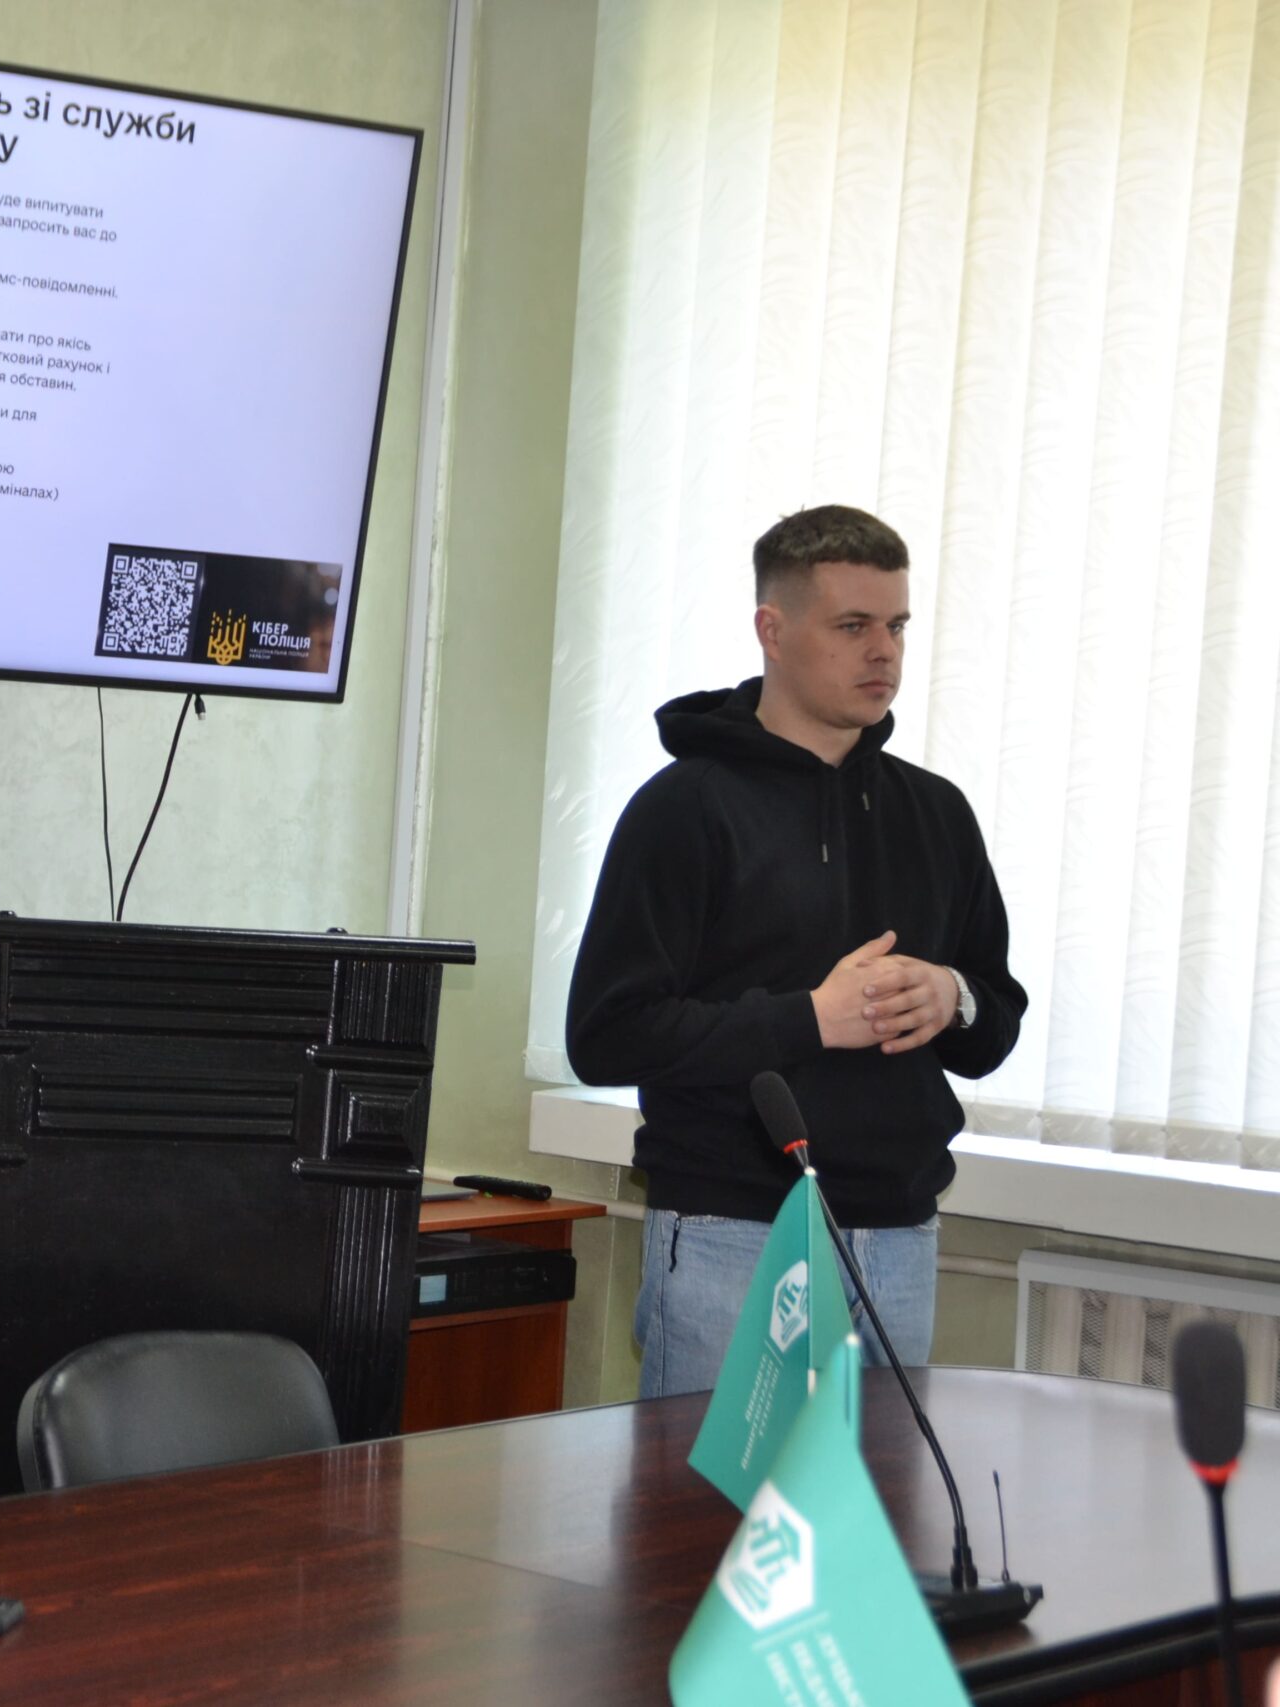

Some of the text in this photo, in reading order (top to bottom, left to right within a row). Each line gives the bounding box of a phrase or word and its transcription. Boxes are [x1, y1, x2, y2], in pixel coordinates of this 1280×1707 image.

[22, 91, 52, 123] зі
[61, 102, 196, 145] служби
[24, 197, 104, 219] випитувати
[72, 225, 97, 239] вас
[98, 229, 118, 243] до
[26, 332, 54, 348] про
[56, 336, 92, 352] якісь
[46, 356, 104, 374] рахунок
[105, 362, 111, 374] і
[8, 372, 76, 392] обставин.
[10, 408, 38, 422] для
[252, 621, 289, 635] КІБЕР
[259, 633, 311, 651] ПОЛІЦІЯ
